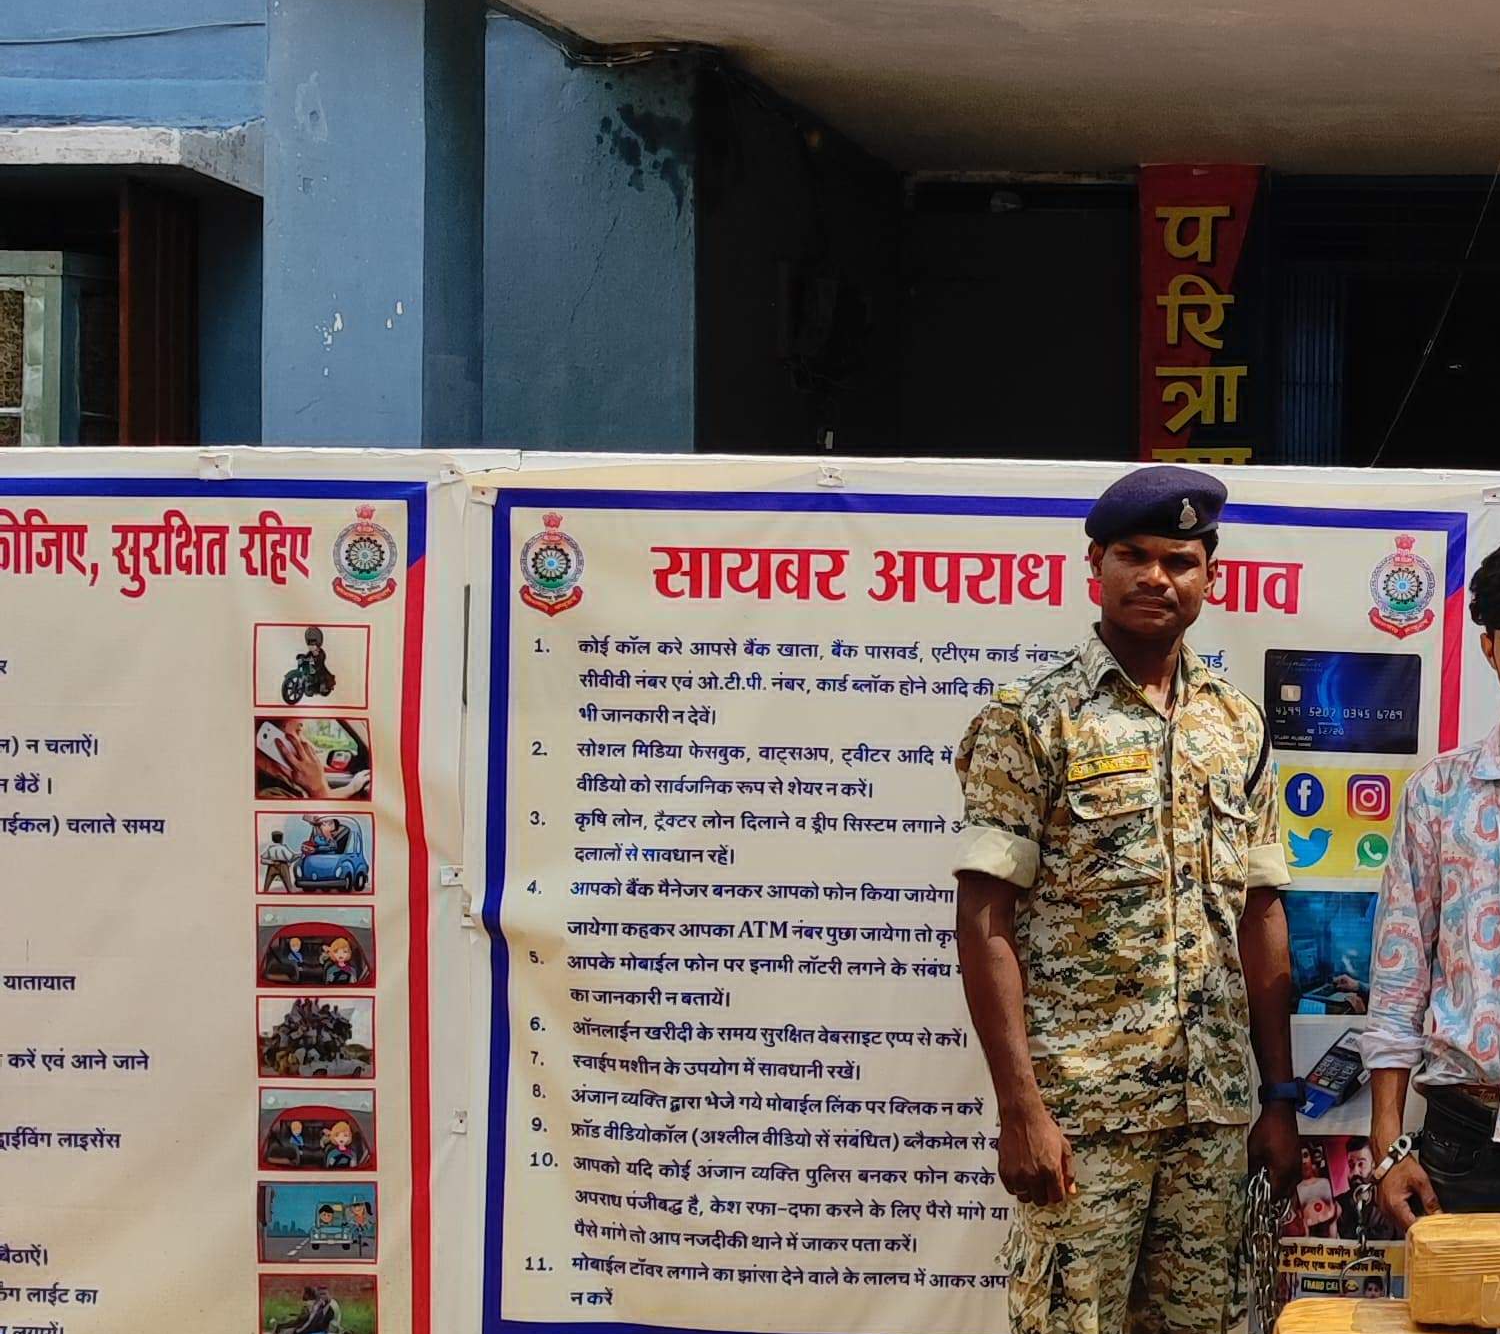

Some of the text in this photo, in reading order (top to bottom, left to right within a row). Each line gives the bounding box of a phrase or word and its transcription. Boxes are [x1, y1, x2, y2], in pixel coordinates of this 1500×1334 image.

[112, 509, 229, 598] सुरक्षित
[239, 510, 312, 585] रहिए
[651, 546, 848, 601] सायबर
[867, 550, 1065, 607] अपराध
[535, 638, 549, 652] 1.
[615, 636, 651, 654] कॉल
[690, 638, 737, 656] आपसे
[932, 642, 980, 663] एटीएम
[579, 669, 631, 688] सीवीवी
[852, 675, 895, 693] ब्लॉक
[932, 677, 971, 697] आदि
[598, 705, 669, 723] जानकारी
[25, 739, 39, 754] न
[532, 741, 547, 755] 2.
[577, 738, 626, 757] सोशल
[632, 739, 683, 758] मिडिया
[898, 745, 934, 765] आदि
[576, 773, 733, 794] वीडियो सार्वजनिक
[66, 813, 117, 834] चलाते
[122, 819, 165, 834] समय
[741, 811, 790, 831] दिलाने
[843, 813, 898, 832] सिस्टम
[902, 815, 946, 833] लगाने
[574, 843, 704, 863] दलालों सावधान
[570, 878, 954, 903] आपको मैनेजर बनकर आपको किया जायेगा
[567, 917, 910, 942] जायेगा कहकर आपका ATM जायेगा
[567, 952, 616, 970] आपके
[619, 952, 680, 973] मोबाईल
[798, 956, 842, 974] लॉटरी
[847, 957, 886, 976] लगने
[912, 958, 952, 977] संबंध
[3, 975, 76, 991] यातायात
[592, 987, 662, 1005] जानकारी
[530, 1017, 883, 1047] 6. ऑनलाईन खरीदी समय सुरक्षित वेबसाइट
[7, 1047, 37, 1069] करें
[41, 1047, 65, 1071] एवं
[71, 1049, 107, 1070] आने
[112, 1049, 149, 1070] जाने
[573, 1052, 824, 1078] स्वाईप मशीन उपयोग सावधानी
[572, 1084, 938, 1115] अंजान व्यक्ति मोबाईल लिंक क्लिक
[57, 1127, 121, 1151] लाइसेंस
[604, 1121, 688, 1143] वीडियोकॉल
[762, 1127, 811, 1147] वीडियो
[903, 1131, 968, 1149] ब्लैकमेल
[530, 1152, 996, 1188] 10. आपको अंजान व्यक्ति पुलिस बनकर करके
[575, 1190, 622, 1208] अपराध
[825, 1199, 864, 1217] करने
[683, 1230, 849, 1251] नजदीकी जाकर
[525, 1257, 552, 1271] 11.
[572, 1252, 626, 1275] मोबाईल
[666, 1262, 709, 1280] लगाने
[737, 1264, 778, 1284] झांसा
[863, 1273, 910, 1285] लालच
[929, 1274, 976, 1288] आकर
[26, 1282, 70, 1307] लाईट
[75, 1289, 98, 1304] का
